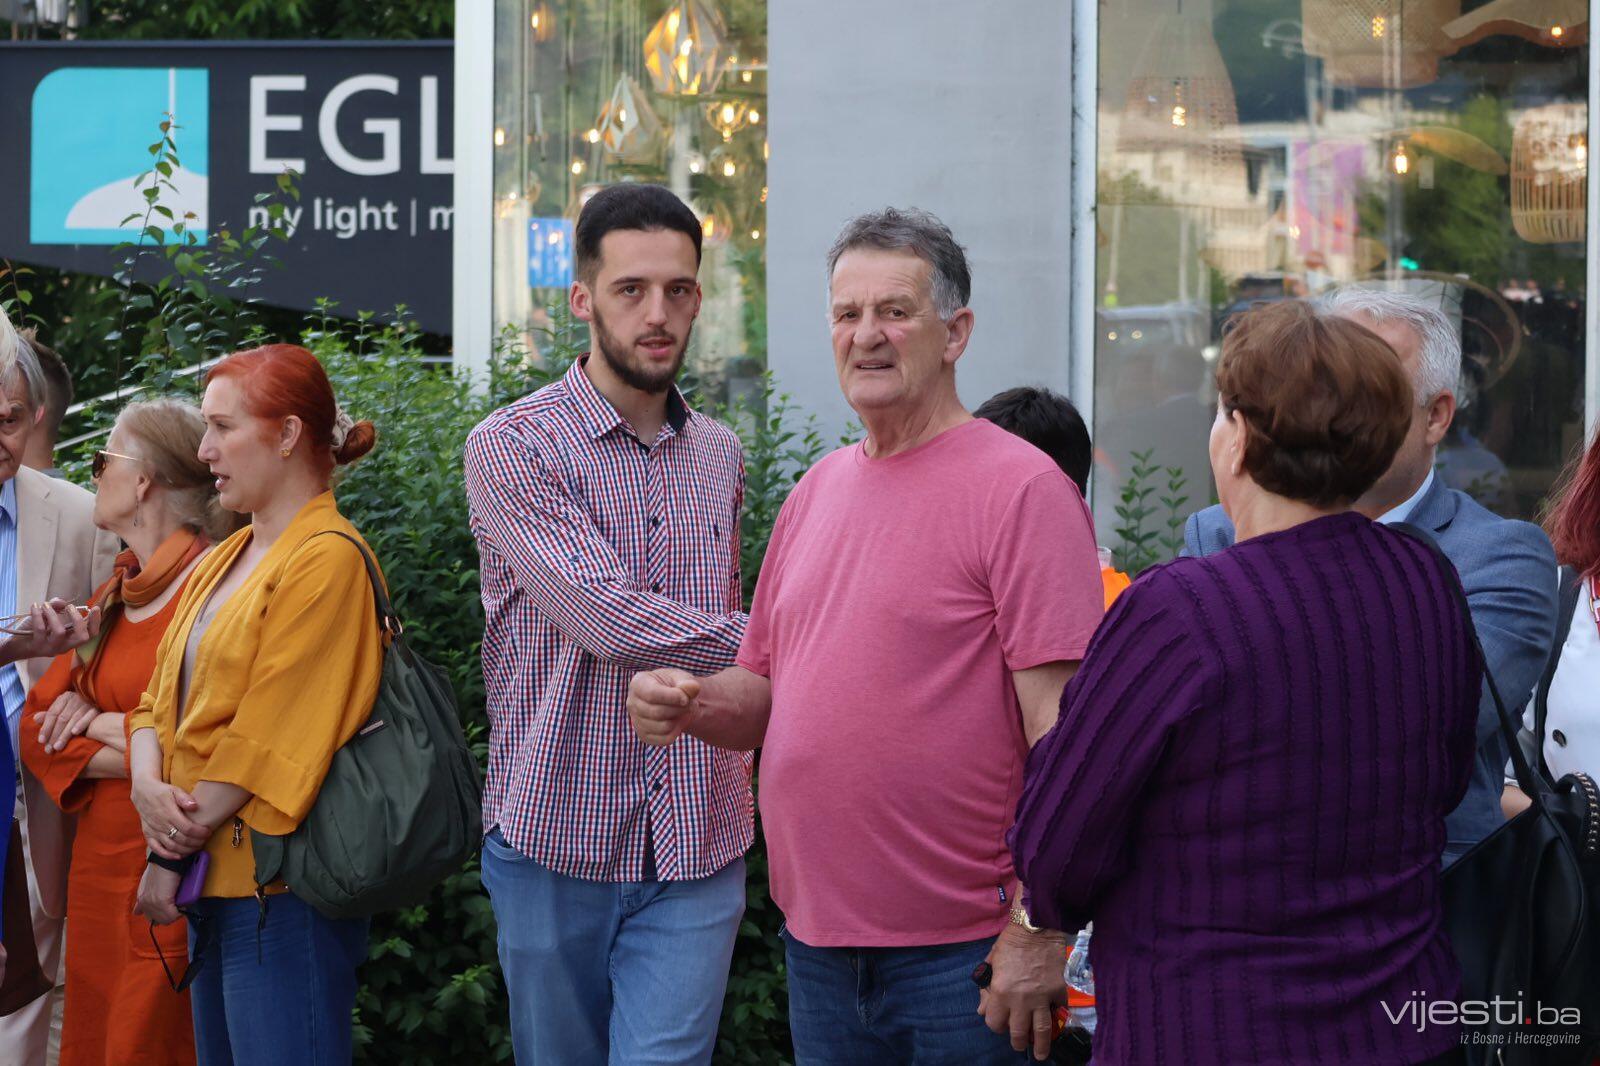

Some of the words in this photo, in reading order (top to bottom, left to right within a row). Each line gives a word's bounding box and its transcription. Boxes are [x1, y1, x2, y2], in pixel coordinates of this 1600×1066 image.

[249, 74, 454, 175] EGL
[249, 206, 303, 238] my
[313, 198, 399, 239] light
